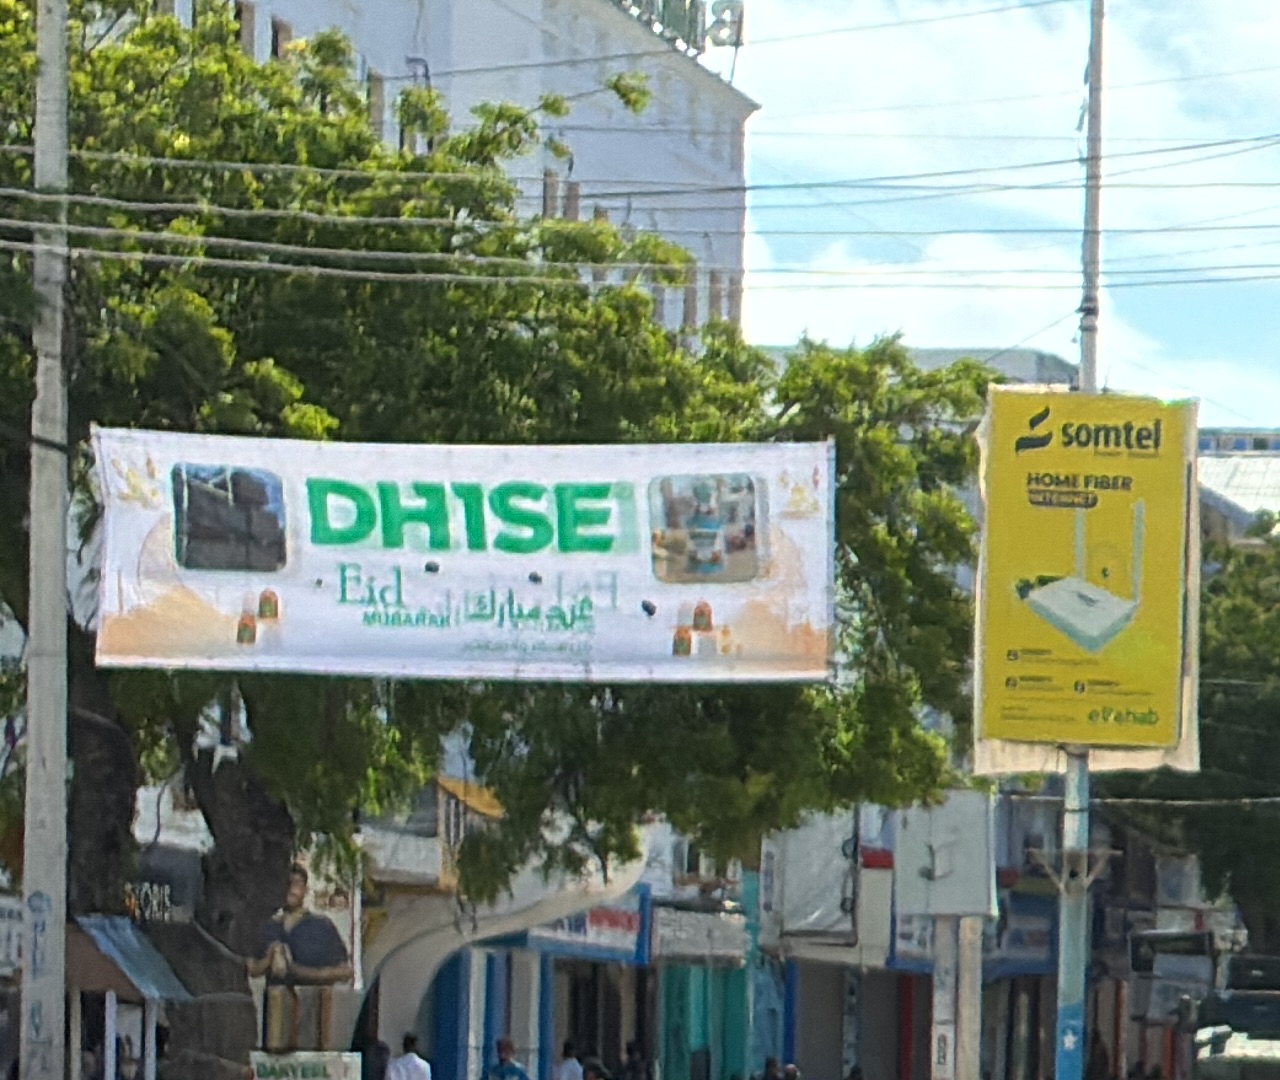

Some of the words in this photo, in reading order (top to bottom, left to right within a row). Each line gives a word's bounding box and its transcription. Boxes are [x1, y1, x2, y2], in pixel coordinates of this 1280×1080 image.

[1061, 418, 1161, 450] somtel
[1026, 472, 1080, 489] HOME
[1083, 474, 1133, 491] FIBER
